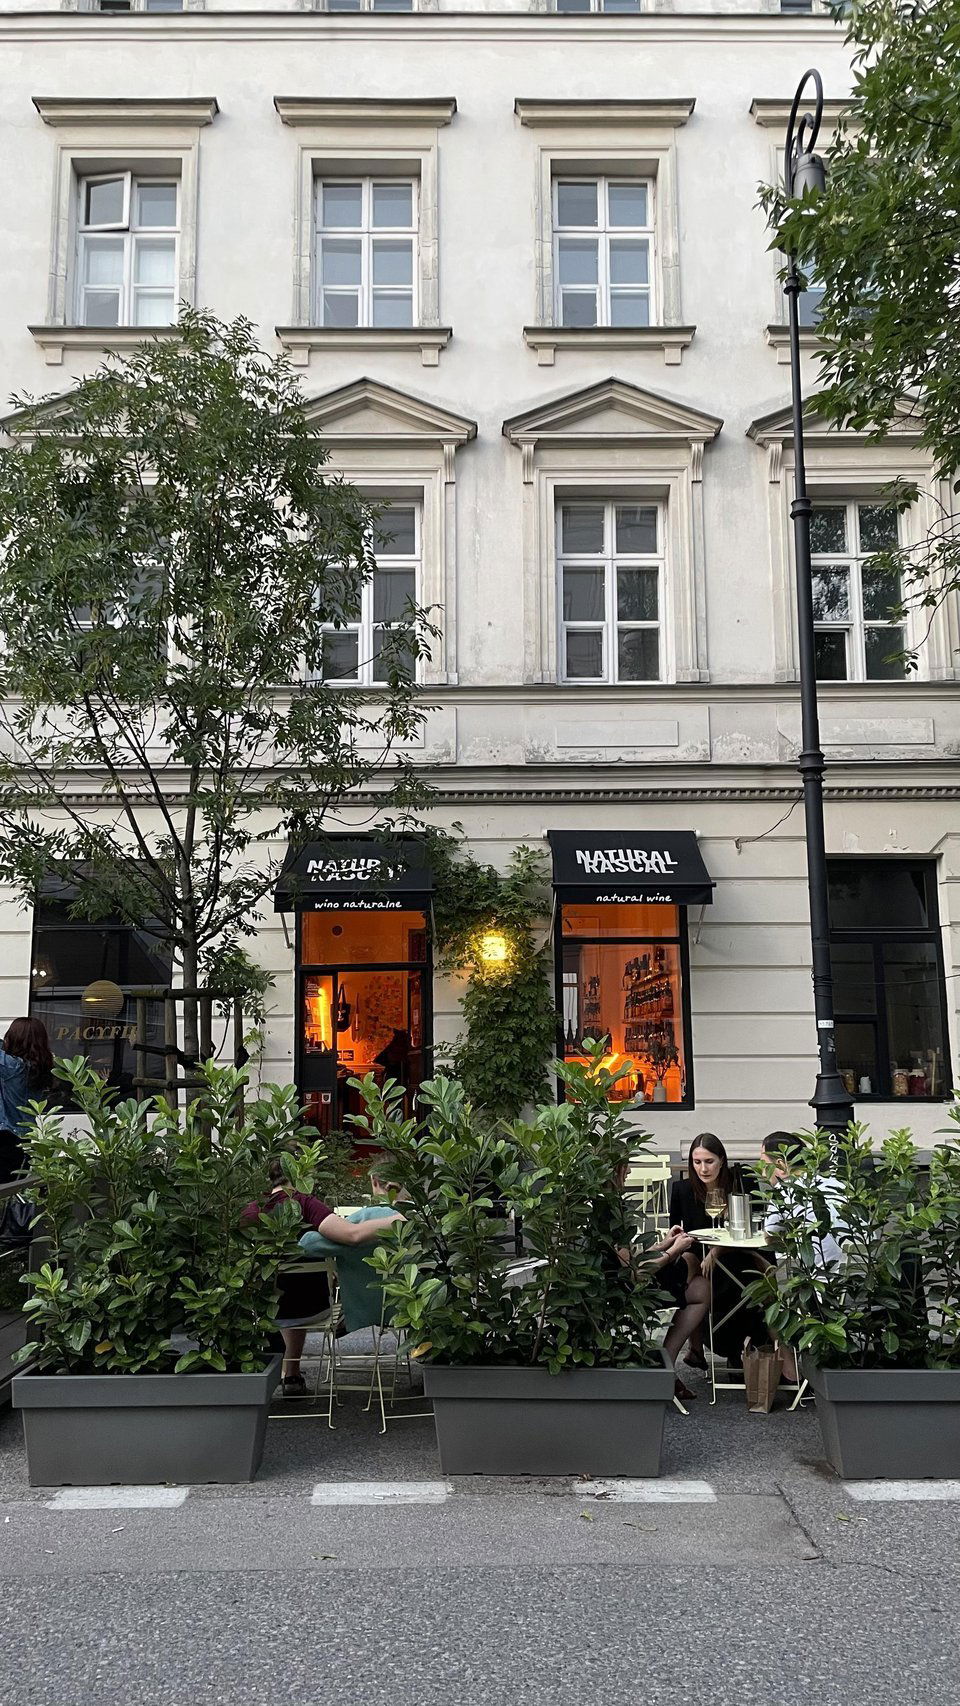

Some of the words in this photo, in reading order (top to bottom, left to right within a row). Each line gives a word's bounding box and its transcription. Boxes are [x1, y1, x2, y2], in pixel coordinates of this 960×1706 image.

[575, 849, 678, 865] NATURAL
[307, 859, 406, 873] NATUR
[584, 859, 674, 873] RASCAL
[315, 899, 340, 909] wino
[343, 900, 402, 909] naturalne
[596, 893, 643, 902] natural
[646, 892, 672, 902] wine
[55, 1026, 137, 1041] PACYFI
